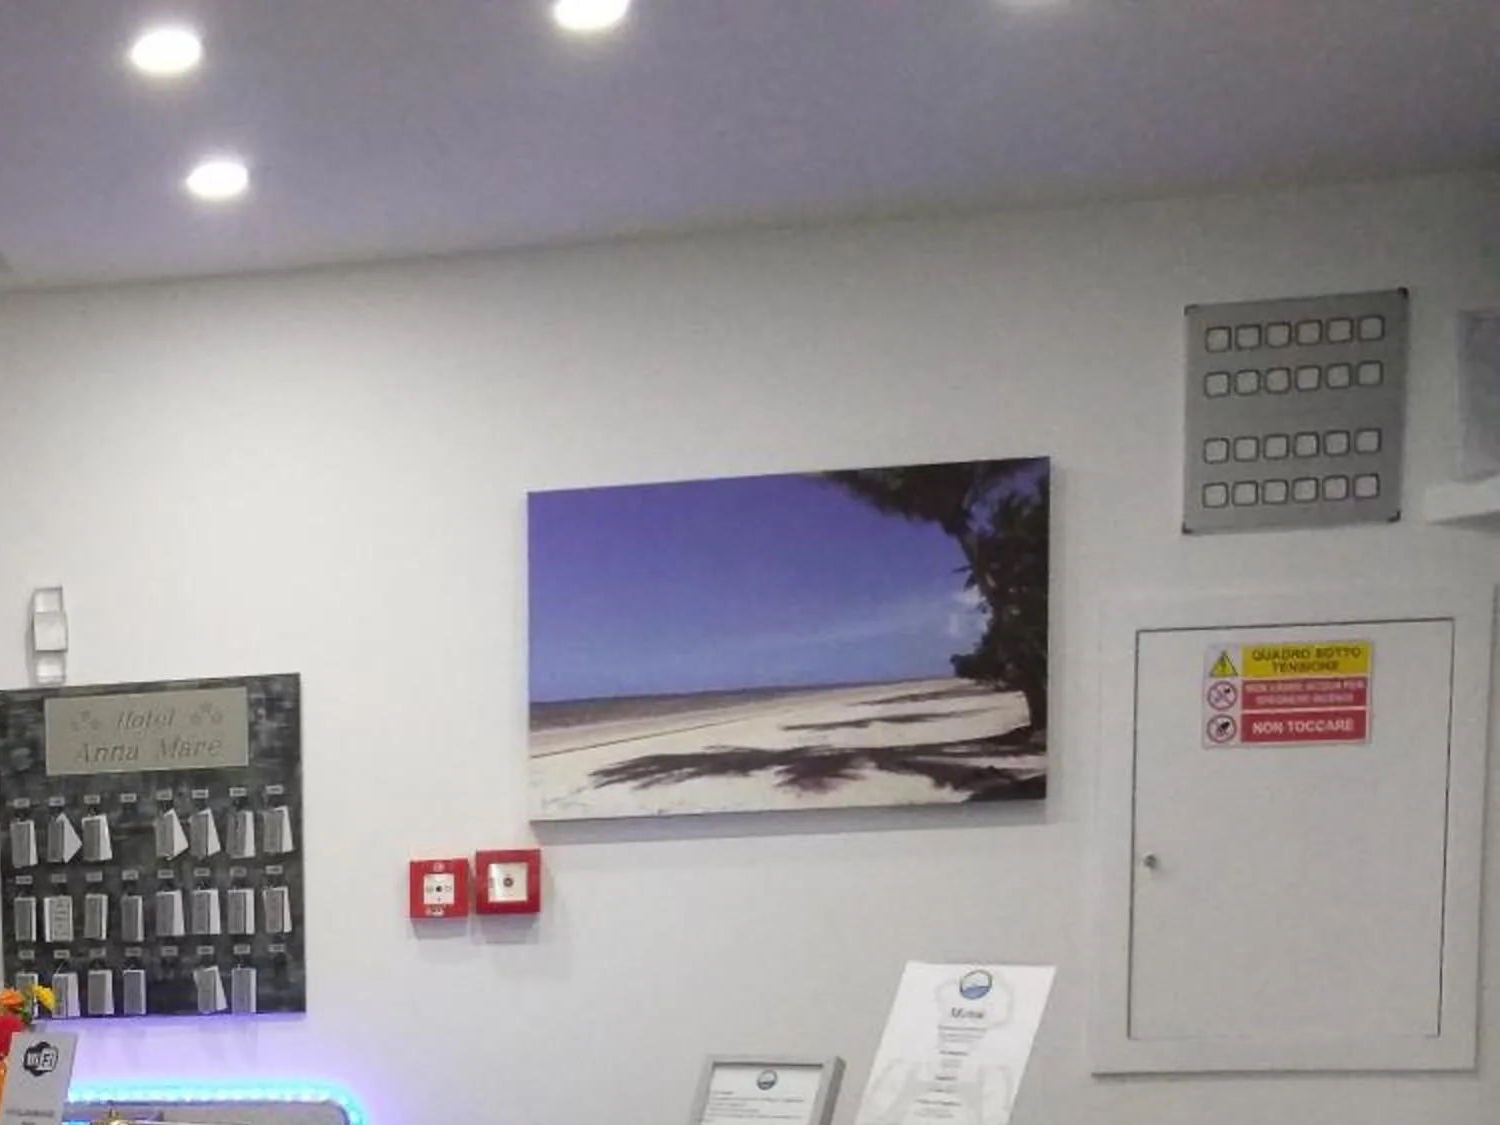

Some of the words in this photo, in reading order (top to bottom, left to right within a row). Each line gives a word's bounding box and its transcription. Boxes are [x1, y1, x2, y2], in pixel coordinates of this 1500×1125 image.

[1251, 647, 1310, 661] QUADRO
[1315, 646, 1361, 659] SOTTO
[117, 708, 176, 730] Hotel
[1252, 721, 1284, 734] NON
[1288, 718, 1356, 733] TOCCARE
[77, 742, 140, 763] Anna
[156, 735, 222, 760] Mare
